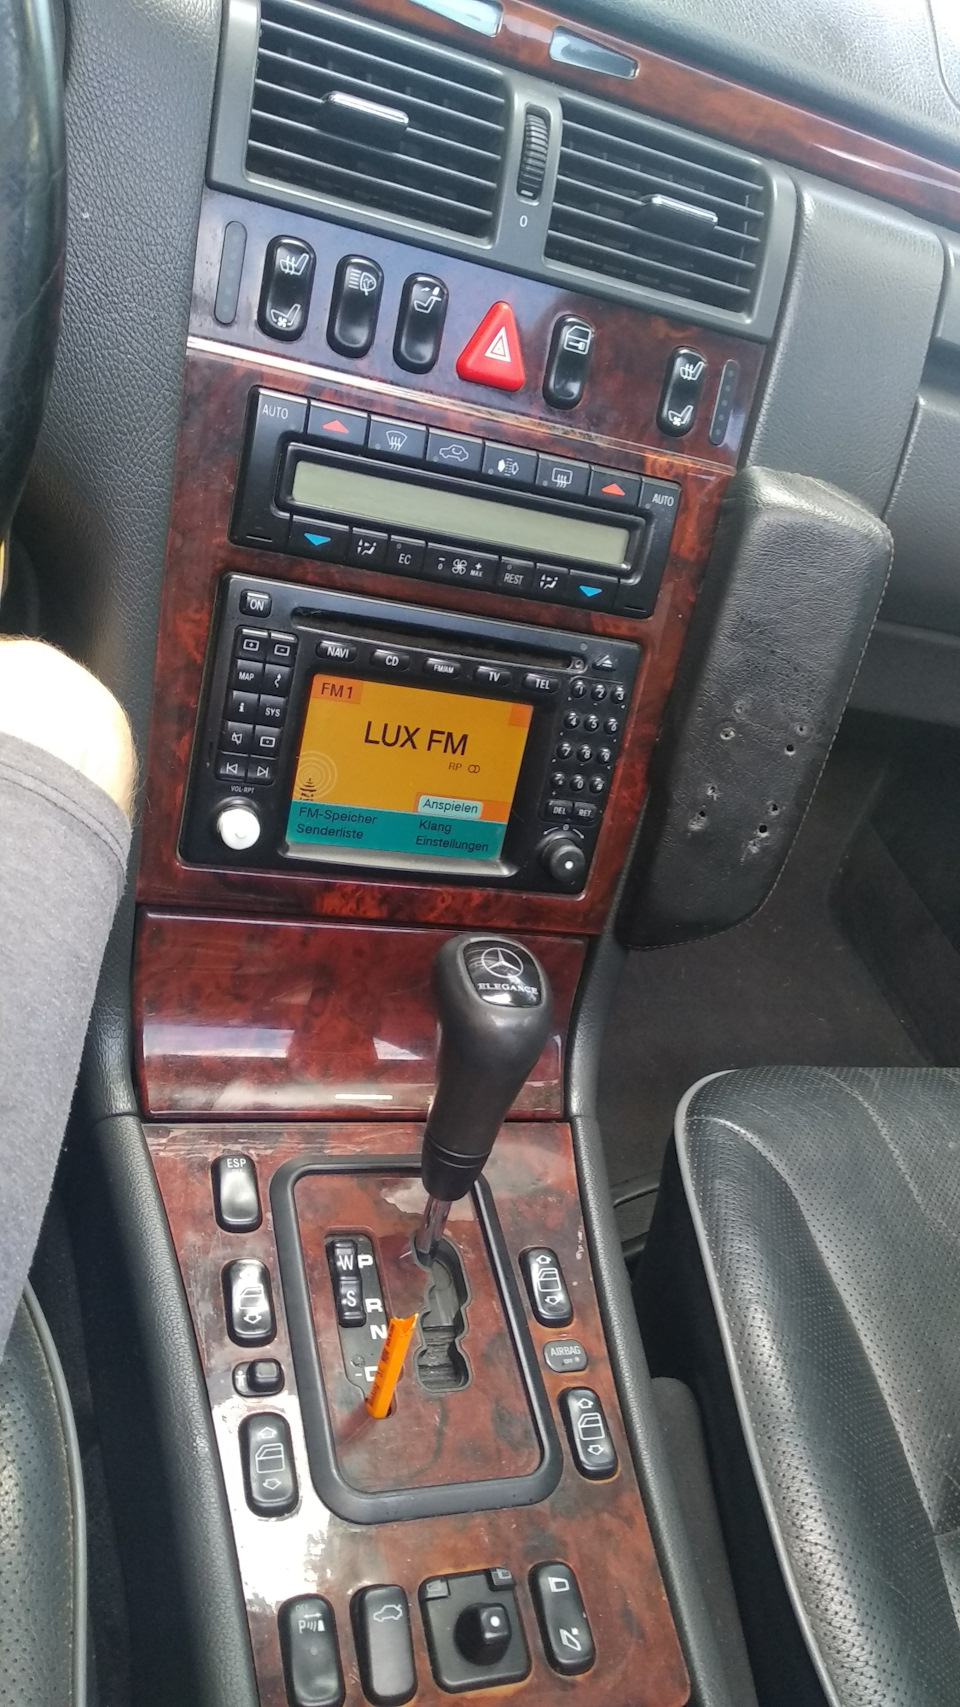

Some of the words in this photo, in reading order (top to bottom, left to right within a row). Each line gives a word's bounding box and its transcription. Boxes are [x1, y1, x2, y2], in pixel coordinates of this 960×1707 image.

[262, 403, 289, 420] AUTO
[651, 493, 675, 507] AUTO
[398, 553, 412, 565] EC
[470, 569, 483, 578] MAX
[503, 573, 524, 585] REST
[250, 599, 264, 611] ON
[327, 646, 349, 659] NAVI
[385, 655, 399, 667] CD
[239, 671, 255, 681] MAP
[488, 671, 501, 682] TV
[535, 678, 551, 690] TEL
[265, 707, 281, 718] SYS
[363, 720, 421, 750] LUX
[426, 729, 469, 756] FM
[448, 761, 462, 772] RP
[422, 798, 479, 814] Anspielen
[552, 806, 566, 815] DEL
[578, 808, 592, 817] RET
[298, 806, 378, 825] FM-Speicher
[296, 823, 364, 840] Senderliste
[418, 820, 452, 835] Klang
[415, 835, 489, 853] Einstellungen
[477, 982, 539, 995] ELEGANCE
[226, 1158, 247, 1168] ESP
[338, 1254, 354, 1271] W
[357, 1254, 374, 1269] P
[346, 1290, 356, 1307] S
[365, 1298, 383, 1313] R
[369, 1324, 388, 1340] N
[550, 1345, 582, 1357] AIRBAG
